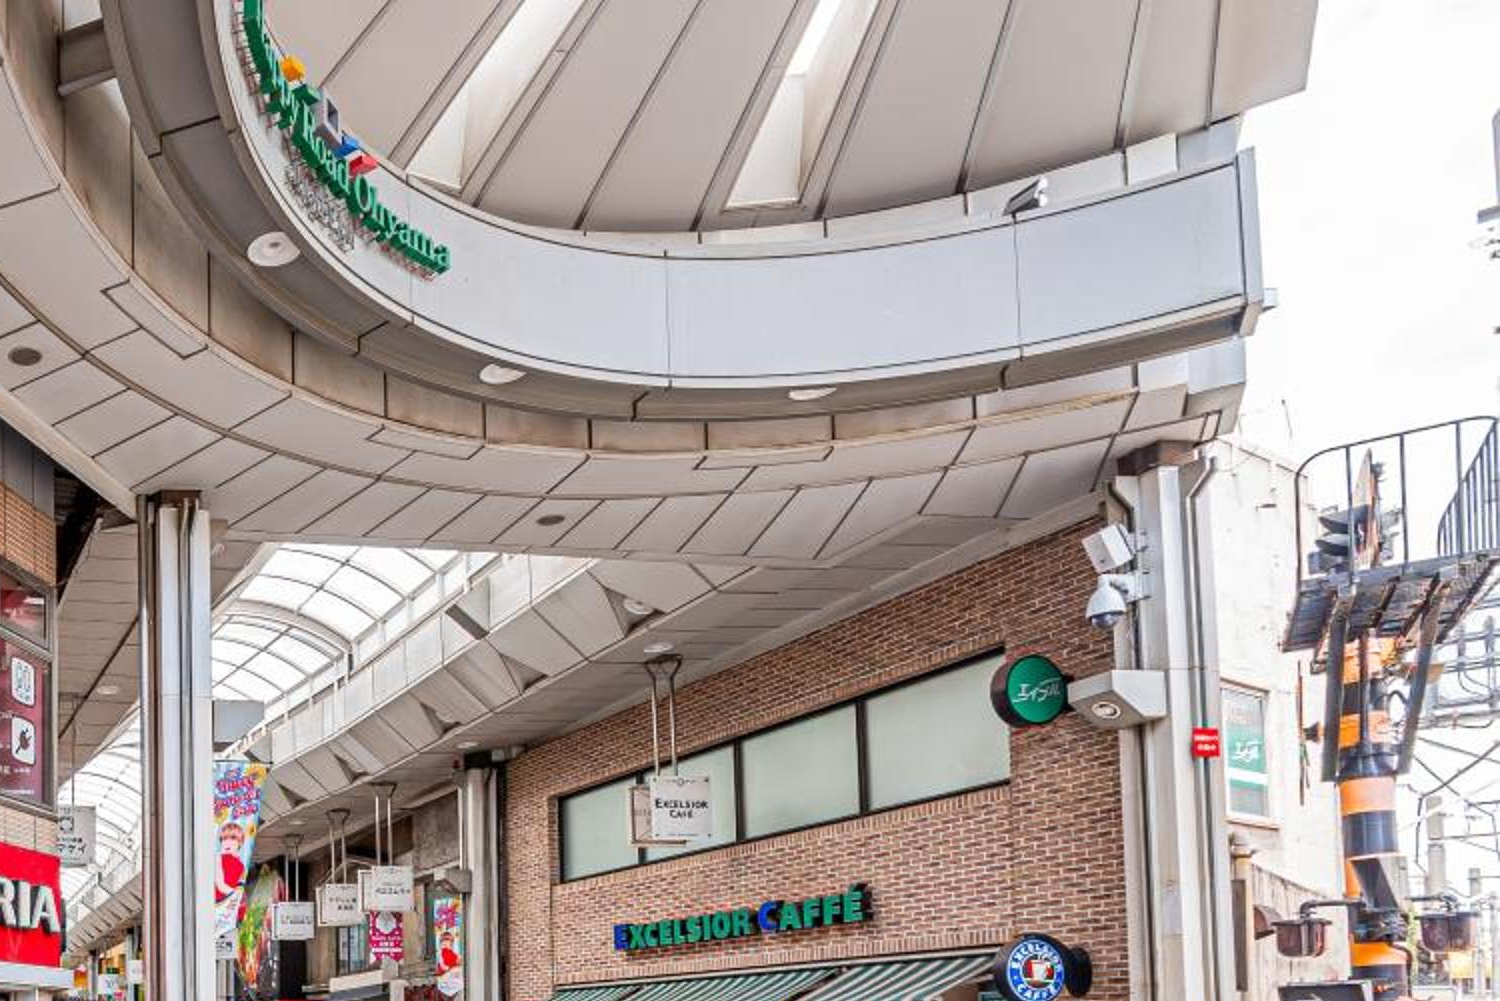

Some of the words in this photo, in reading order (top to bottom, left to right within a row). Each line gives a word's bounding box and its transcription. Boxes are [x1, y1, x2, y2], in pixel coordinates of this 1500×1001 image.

[300, 104, 350, 194] Road
[352, 175, 451, 270] Ohyama
[655, 798, 709, 809] EXCELSIOR
[614, 907, 751, 950] EXCELSIOR
